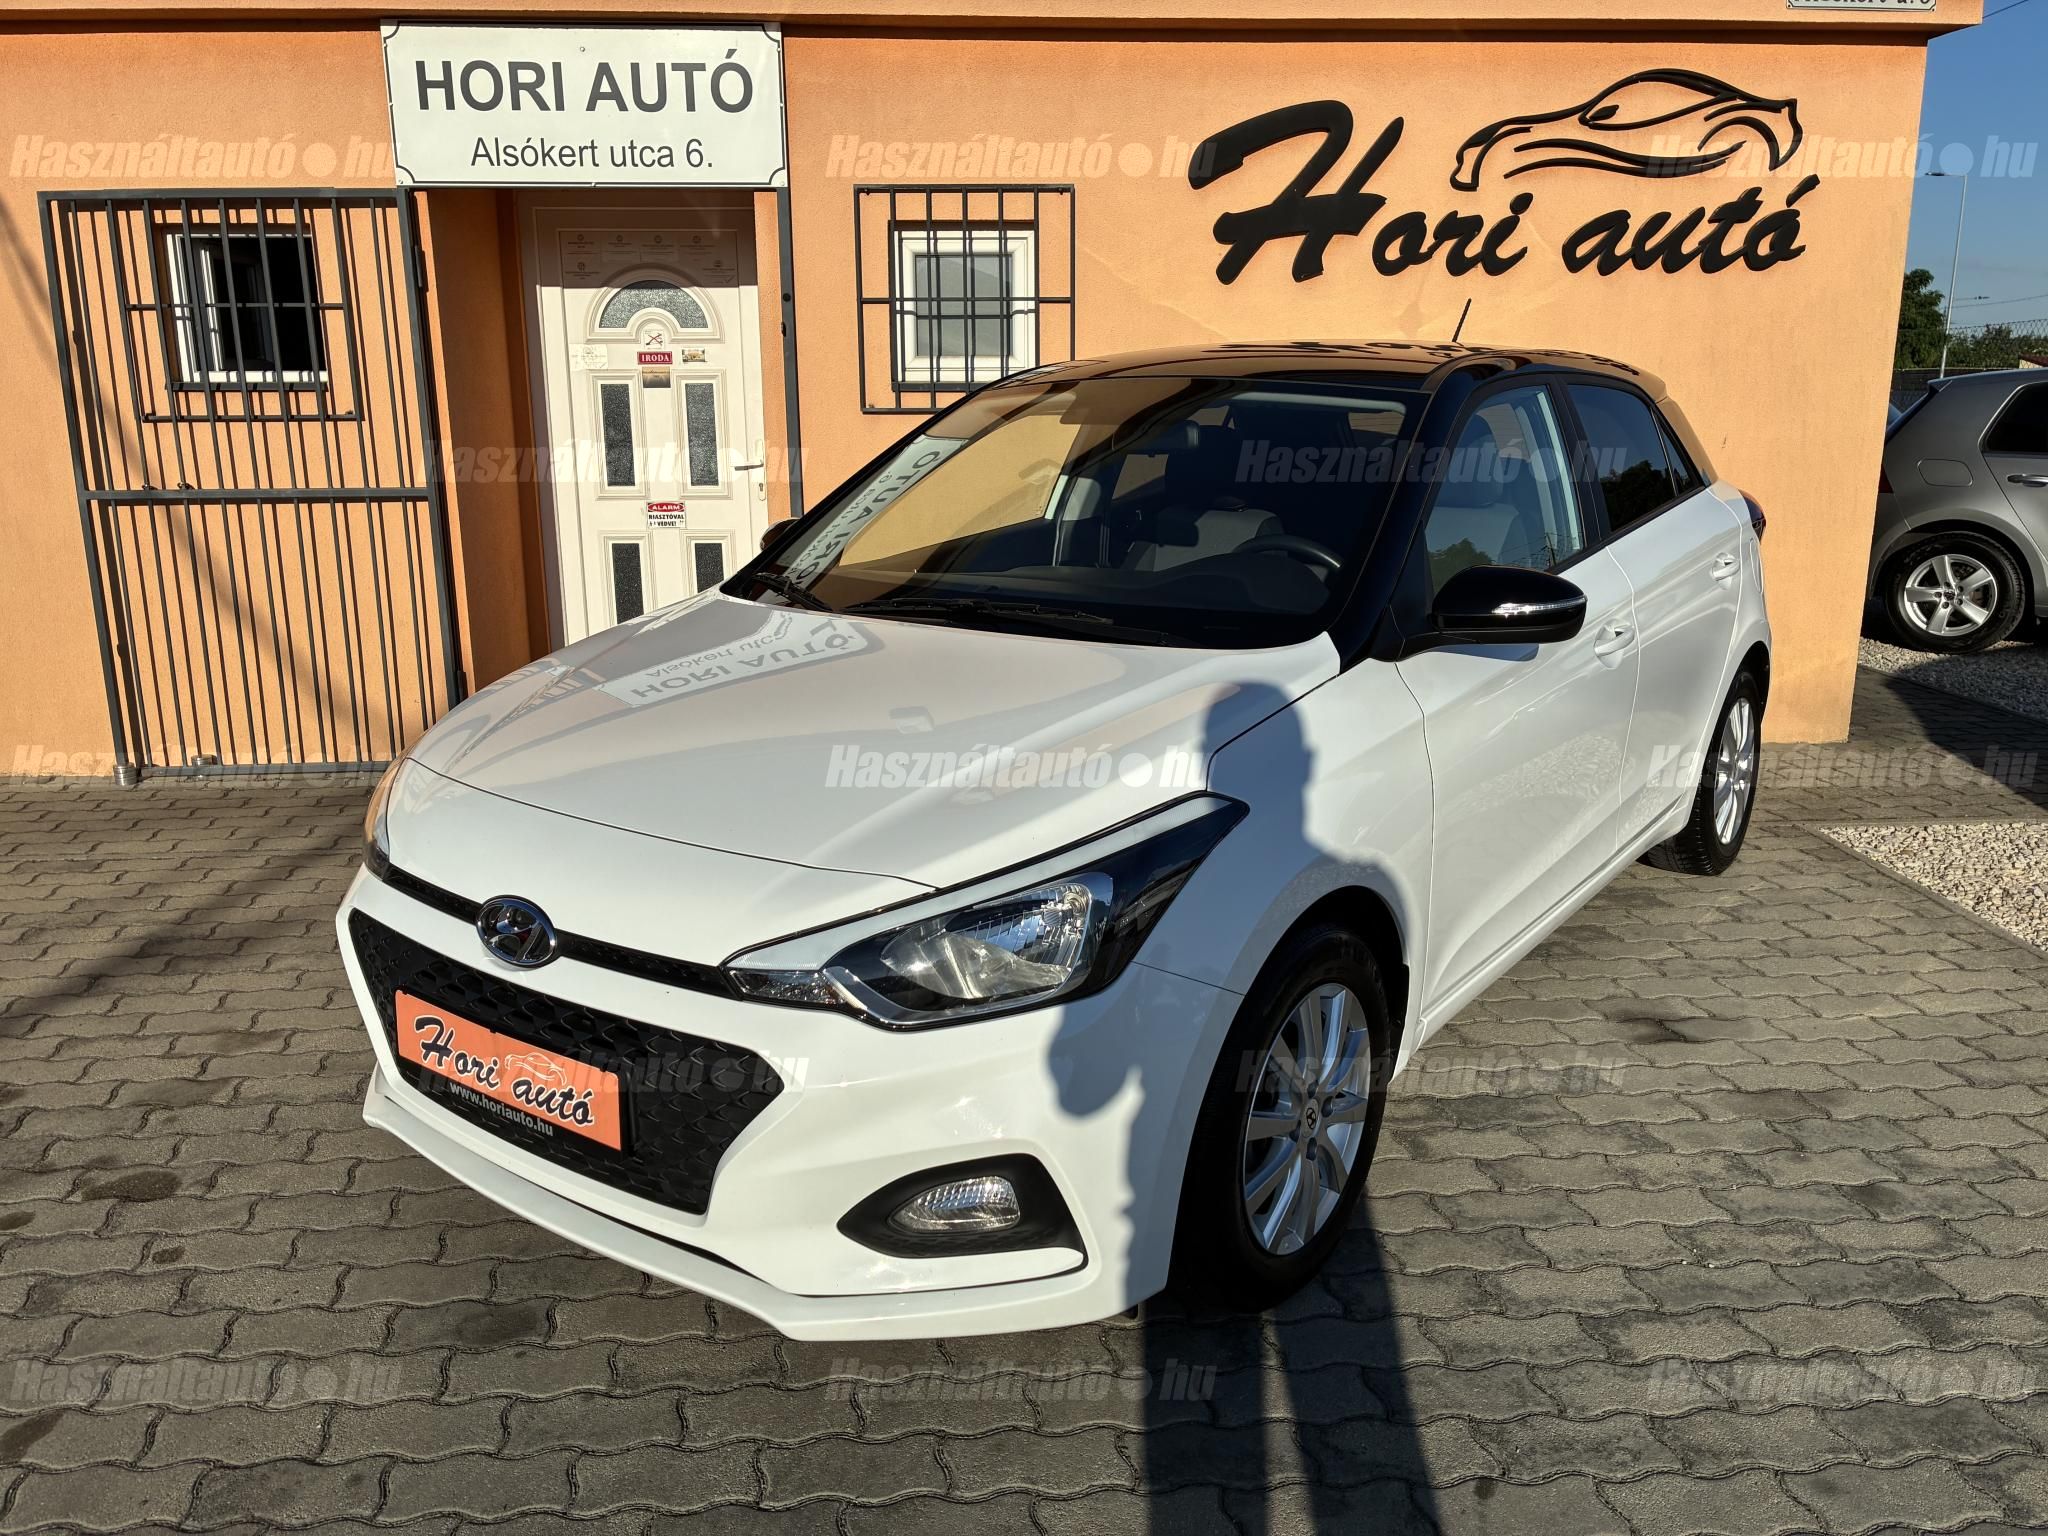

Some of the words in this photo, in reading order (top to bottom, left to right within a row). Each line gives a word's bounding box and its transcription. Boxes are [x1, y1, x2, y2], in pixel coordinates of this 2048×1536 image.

[415, 60, 566, 112] HORI
[585, 48, 753, 114] AUTÓ
[471, 136, 600, 168] Alsókert
[609, 138, 676, 169] utca
[685, 138, 713, 168] 6.
[1189, 100, 1534, 285] Hori
[1560, 173, 1821, 277] autó
[641, 354, 670, 362] IRODA
[414, 1015, 500, 1090] Hori
[511, 1077, 595, 1127] autó
[449, 1081, 554, 1137] www.horiauto.hu
